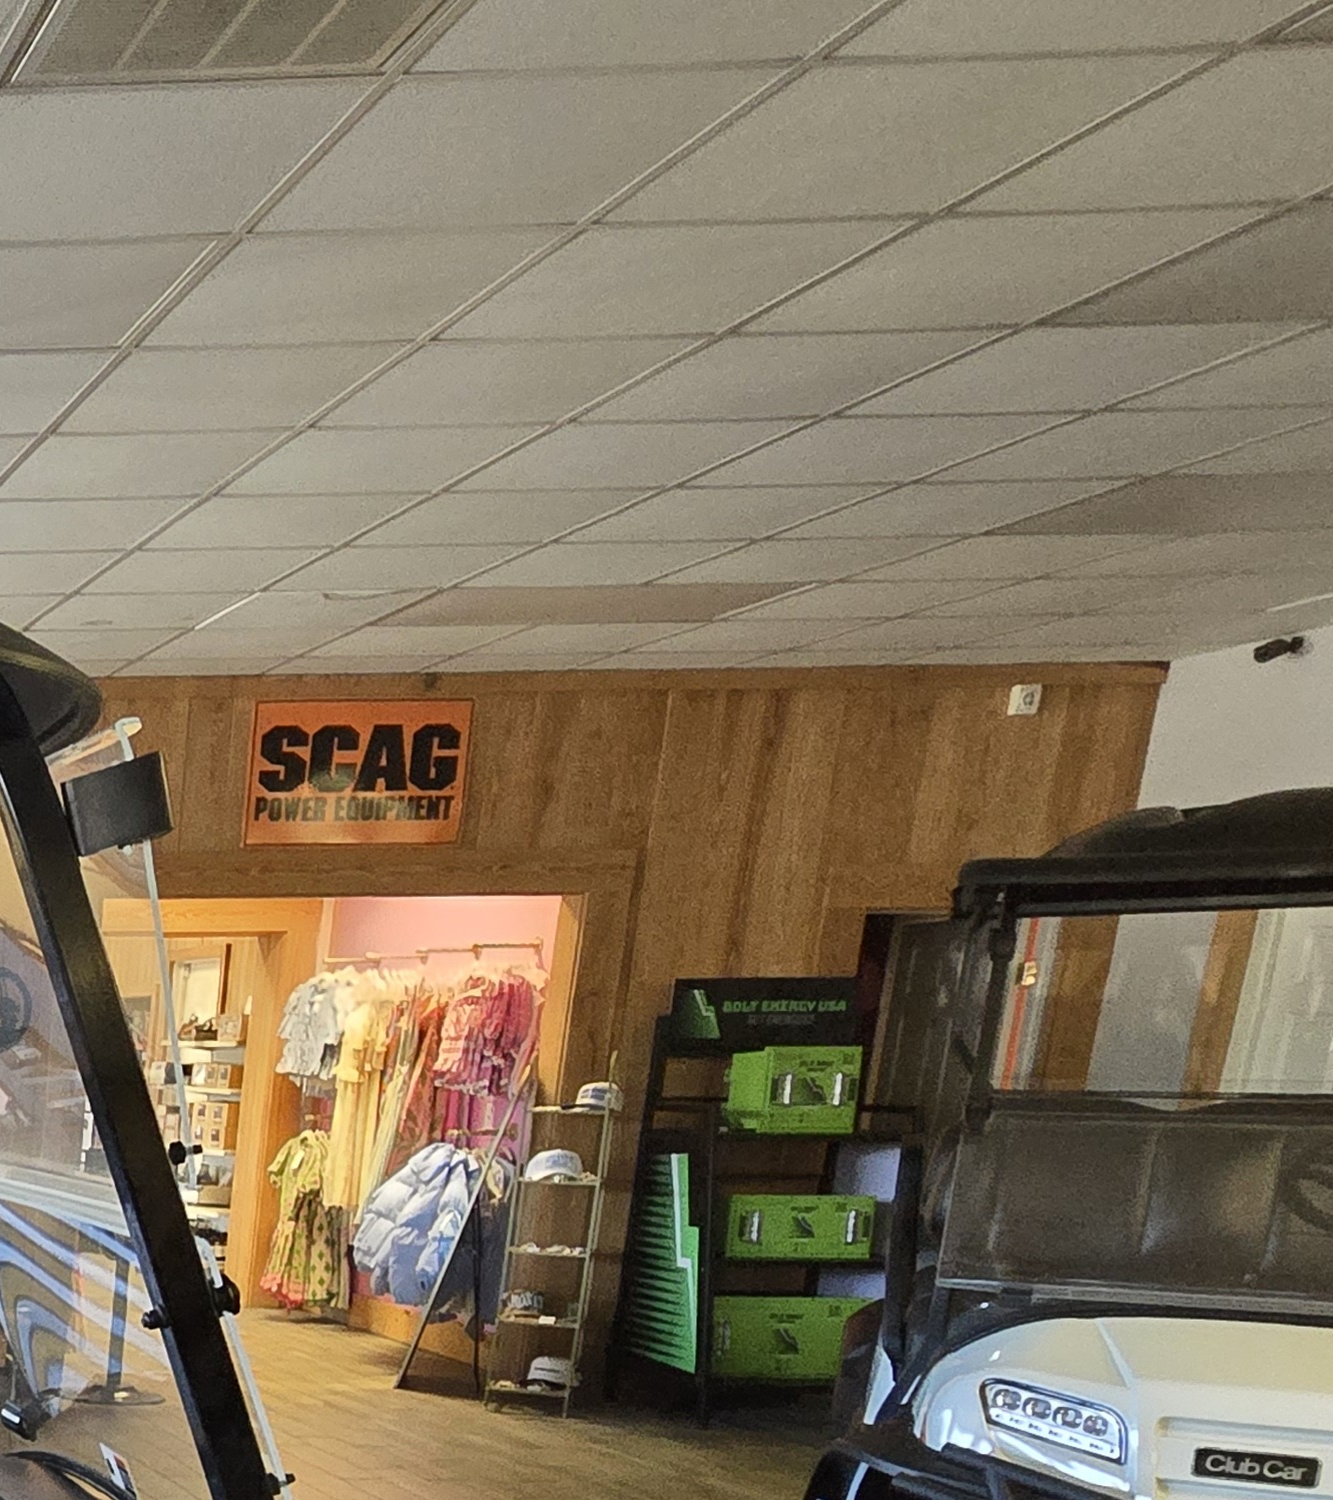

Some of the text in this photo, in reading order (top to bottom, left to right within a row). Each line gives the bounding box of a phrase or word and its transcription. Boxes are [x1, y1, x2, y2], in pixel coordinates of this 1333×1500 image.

[258, 723, 462, 793] SCAG
[253, 795, 456, 823] POWER EQUIPMENT
[1204, 1454, 1309, 1481] Club Car
